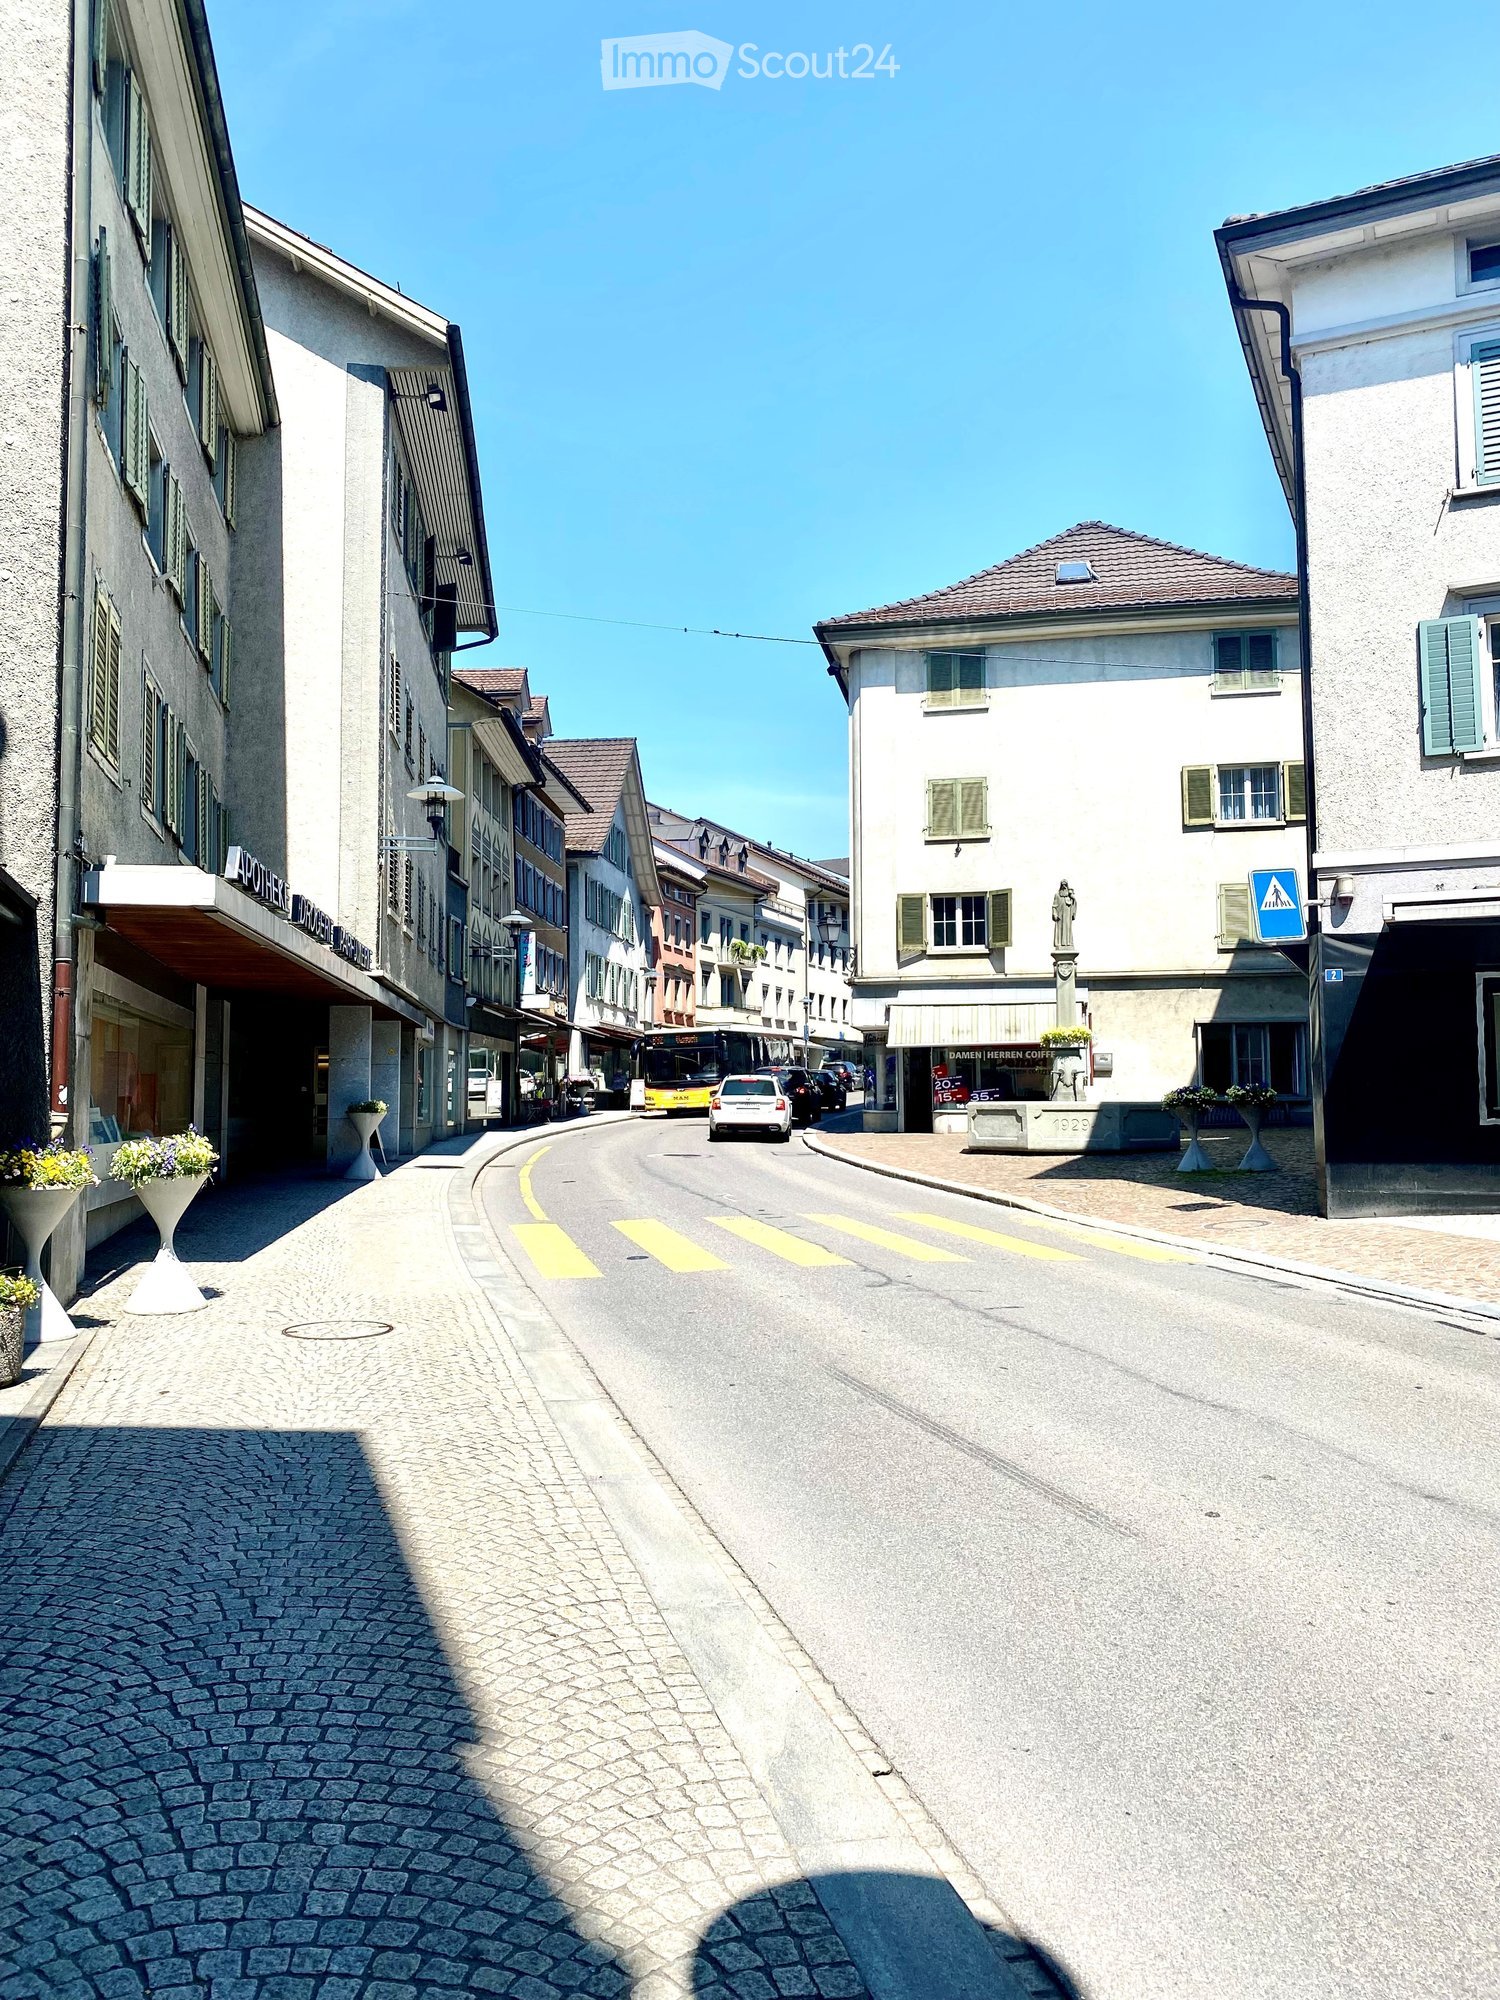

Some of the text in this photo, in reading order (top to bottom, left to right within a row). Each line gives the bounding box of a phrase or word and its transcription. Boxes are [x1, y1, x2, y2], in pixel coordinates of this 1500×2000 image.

[234, 846, 291, 913] APOTHEKE
[294, 895, 334, 945] DROGERIE
[949, 1051, 982, 1059] DAMEN
[987, 1050, 1023, 1059] HERREN
[934, 1080, 961, 1090] 20.-
[938, 1092, 962, 1102] 15.-
[970, 1092, 1000, 1102] 35.-
[1053, 1118, 1090, 1131] 1929
